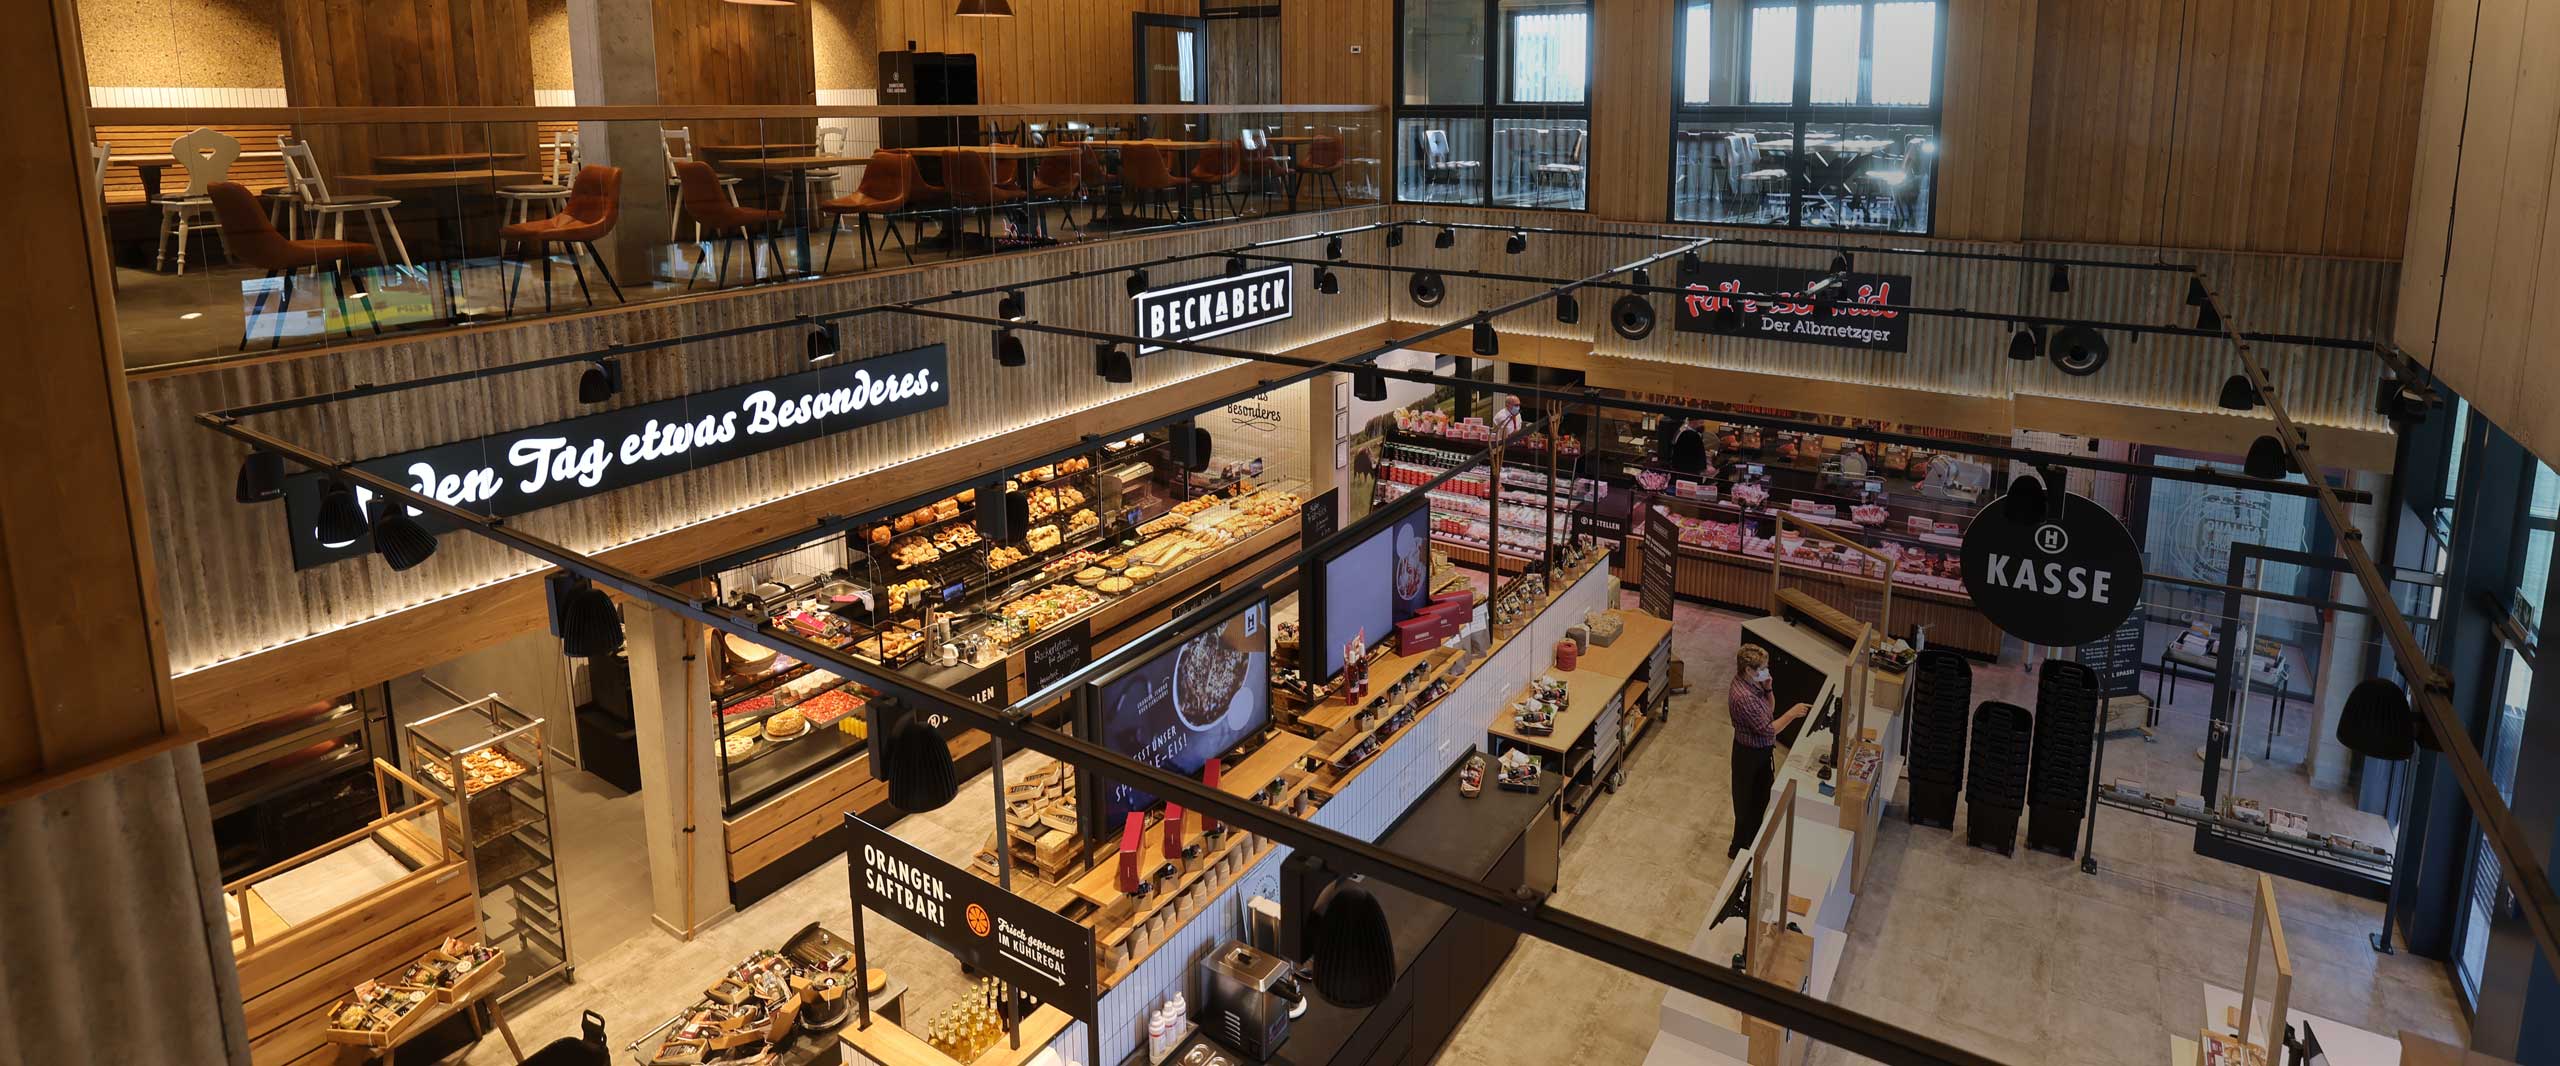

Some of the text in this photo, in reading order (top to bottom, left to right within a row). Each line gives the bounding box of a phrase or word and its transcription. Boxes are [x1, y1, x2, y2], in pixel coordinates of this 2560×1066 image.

[1150, 277, 1286, 338] BECKABECK
[1761, 316, 1891, 343] Der Albmetzger
[508, 435, 613, 494] Tag
[619, 410, 738, 467] etwas
[742, 368, 940, 436] Besonderes.
[1227, 402, 1282, 422] Besonderes
[1986, 552, 2112, 605] KASSE
[864, 844, 952, 902] ORANGEN-
[866, 868, 945, 928] SAFTBAR!
[997, 917, 1066, 960] Frisch gepresst
[998, 932, 1067, 976] IM KÜHLREGAL
